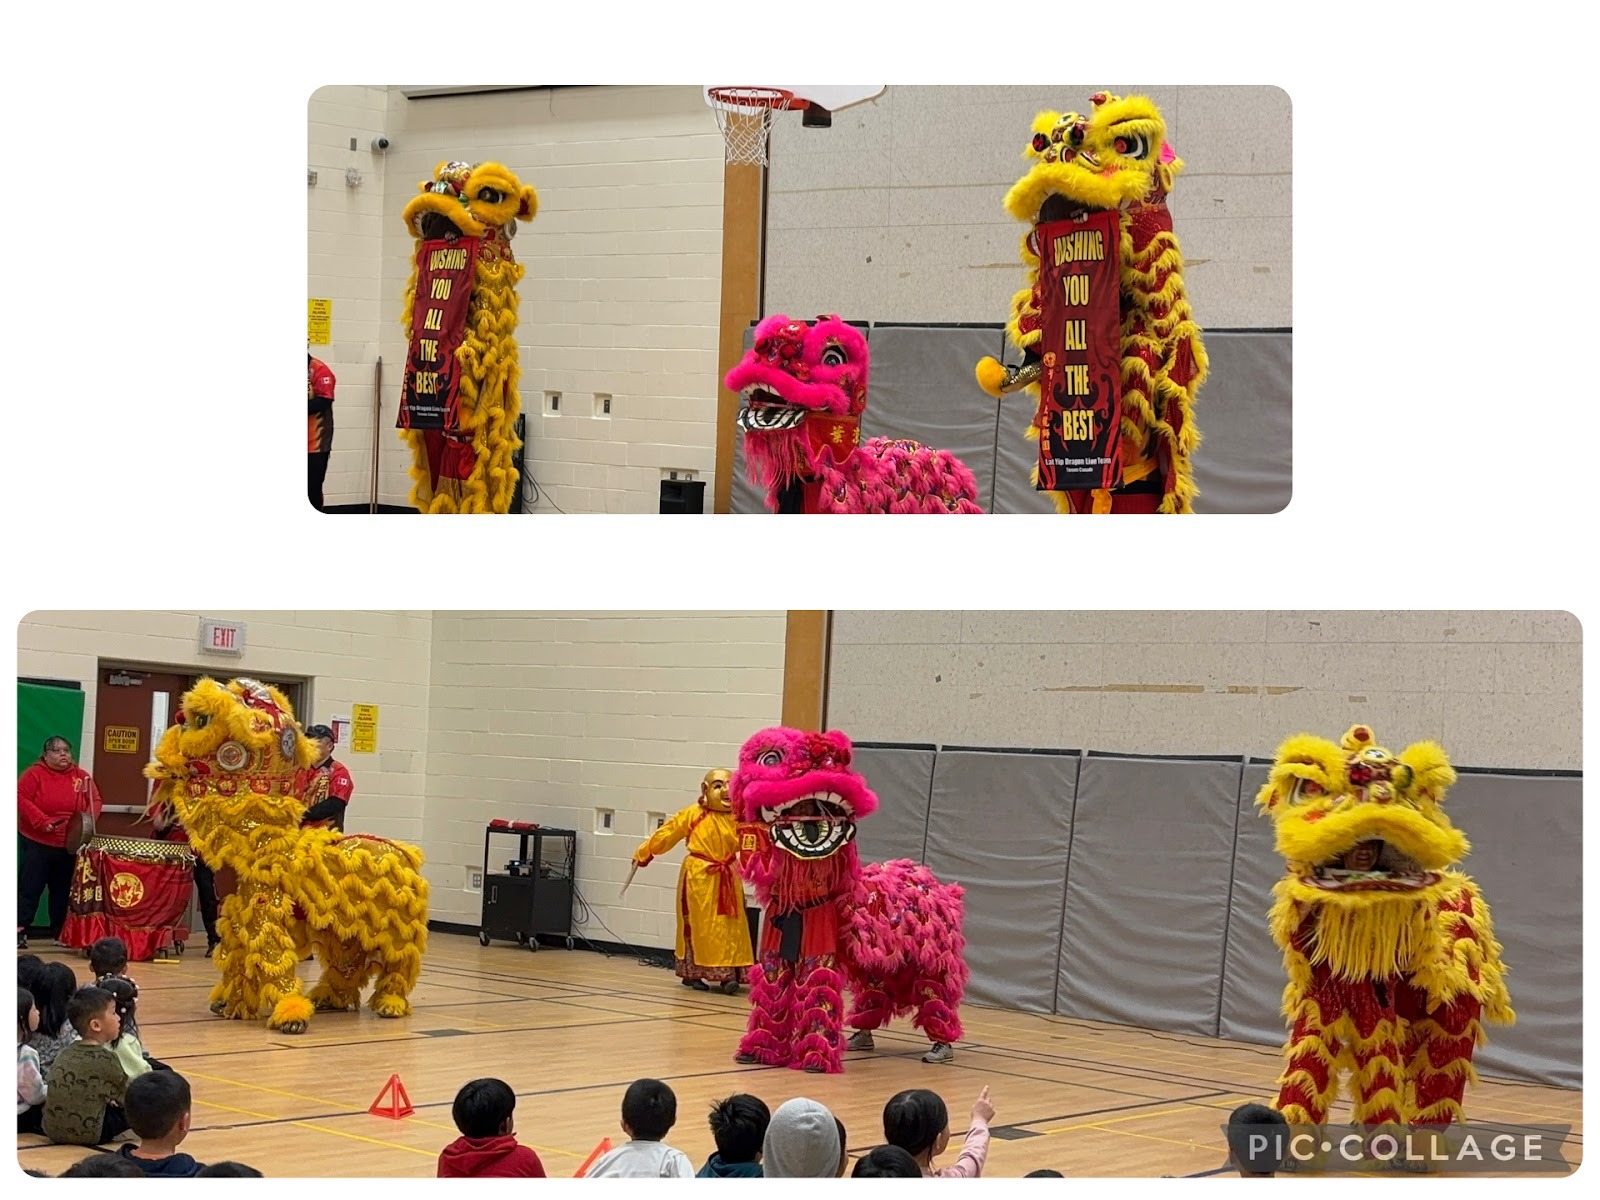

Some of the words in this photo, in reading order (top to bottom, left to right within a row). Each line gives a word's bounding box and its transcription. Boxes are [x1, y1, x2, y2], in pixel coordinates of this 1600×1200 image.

[430, 248, 467, 271] WSHING
[1053, 230, 1104, 267] WSHING
[431, 278, 452, 300] YOU
[1062, 275, 1089, 306] YOU
[424, 309, 444, 331] ALL
[1065, 320, 1087, 350] ALL
[420, 339, 438, 362] THE
[415, 371, 438, 394] BEST
[1064, 365, 1090, 395] THE
[1062, 410, 1095, 441] BEST
[1065, 457, 1085, 466] Dragon
[213, 627, 236, 648] EXIT
[107, 729, 137, 738] CAUTION
